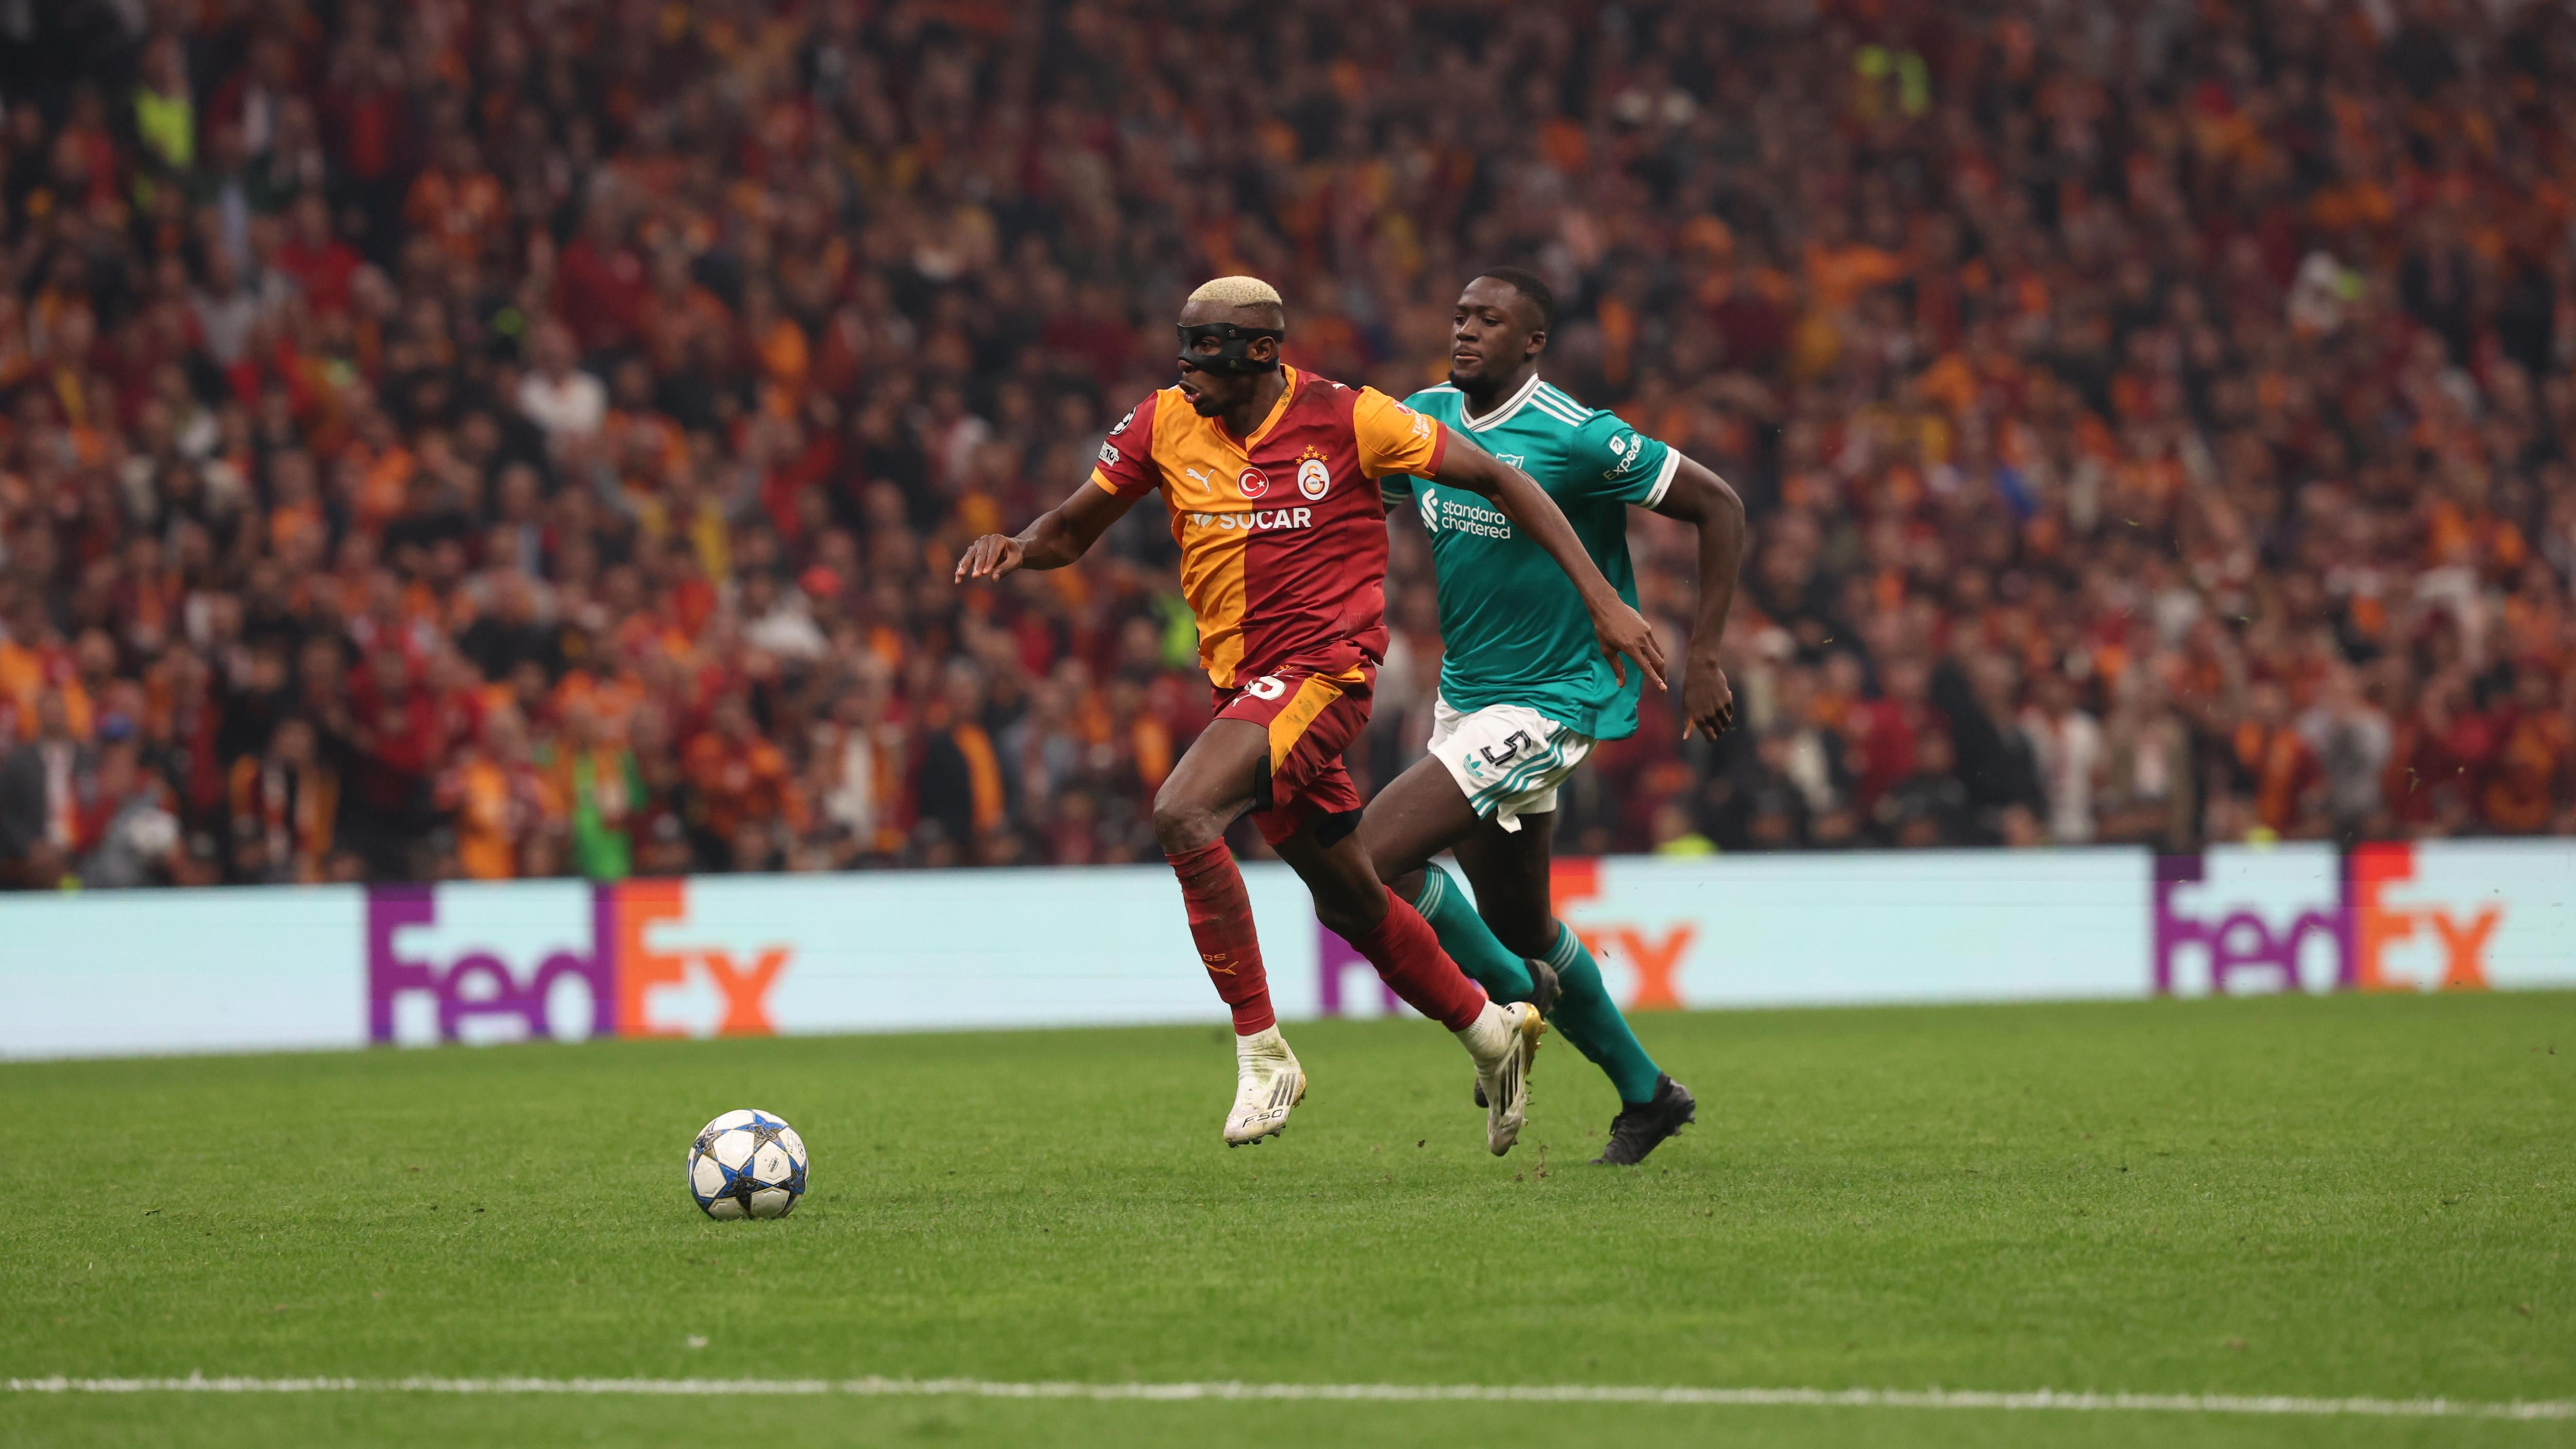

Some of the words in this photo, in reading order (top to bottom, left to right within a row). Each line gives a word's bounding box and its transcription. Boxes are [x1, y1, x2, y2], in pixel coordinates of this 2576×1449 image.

[1219, 507, 1312, 530] SOCAR
[1442, 515, 1511, 539] chartered
[1479, 729, 1531, 768] 5
[2155, 841, 2500, 992] FedEx
[367, 877, 791, 1042] FedEx
[1203, 953, 1226, 962] GS
[1242, 1109, 1283, 1128] F50
